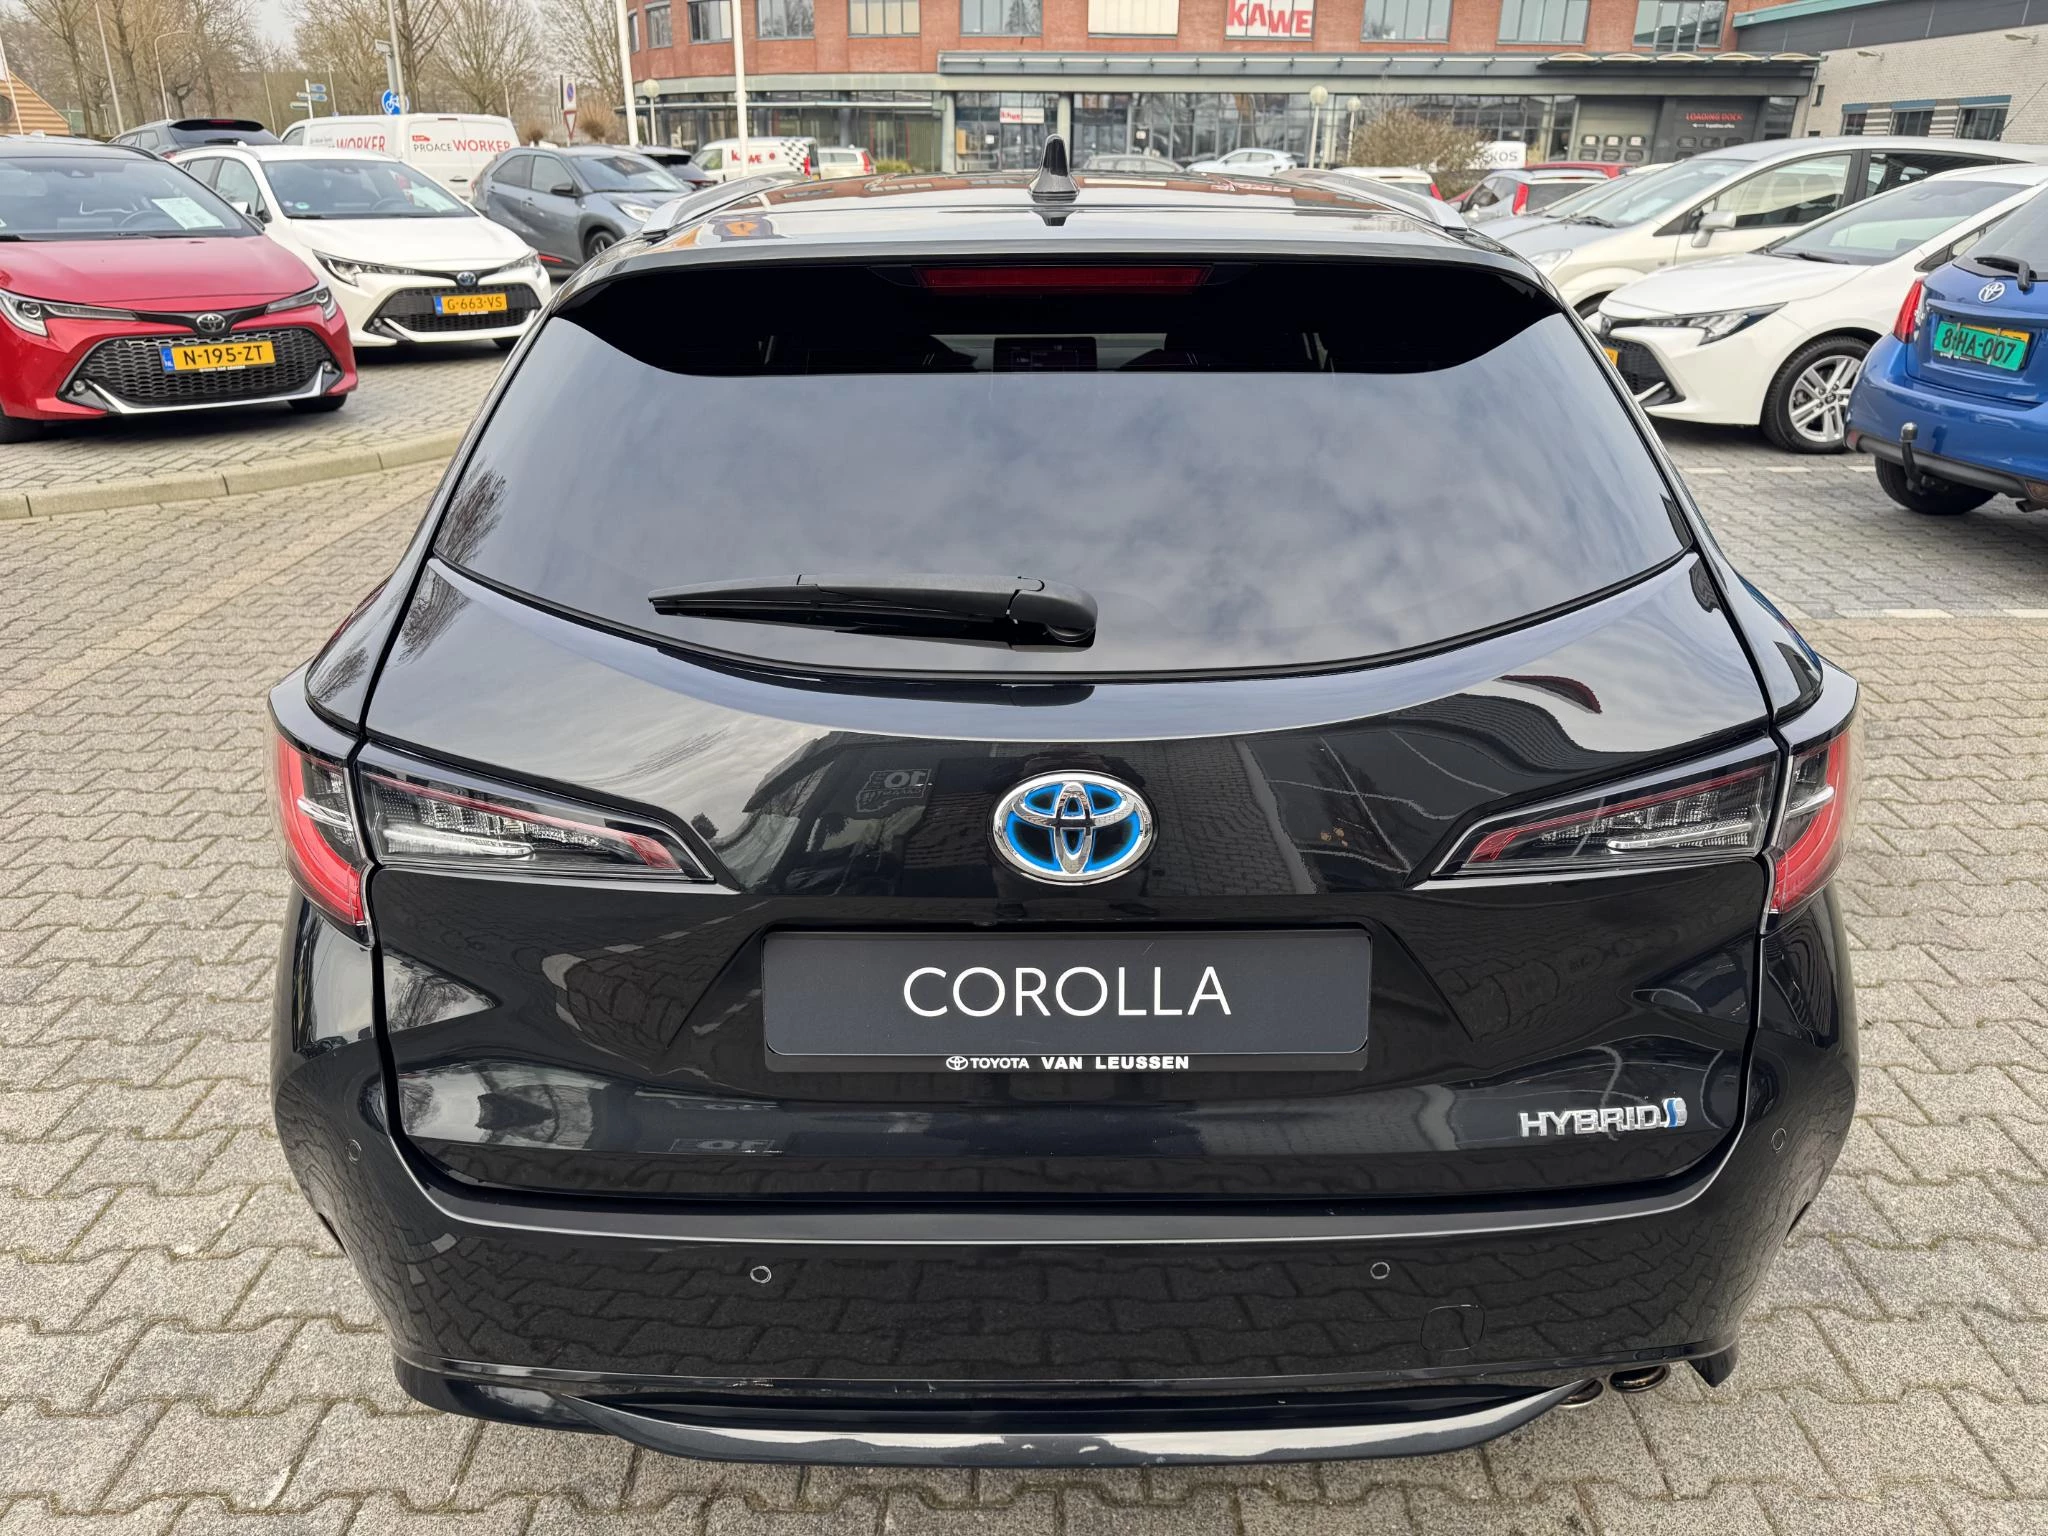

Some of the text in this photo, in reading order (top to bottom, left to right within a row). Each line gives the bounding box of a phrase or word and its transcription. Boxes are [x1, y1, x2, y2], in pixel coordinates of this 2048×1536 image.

[1227, 0, 1312, 33] KAWE
[413, 143, 452, 153] PROACE
[447, 296, 503, 311] G-663-VS
[182, 345, 263, 366] N-195-ZT
[903, 966, 1232, 1017] COROLLA
[970, 1055, 1190, 1070] TOYOTA VAN LEUSSEN
[1519, 1104, 1663, 1138] HYBRID
